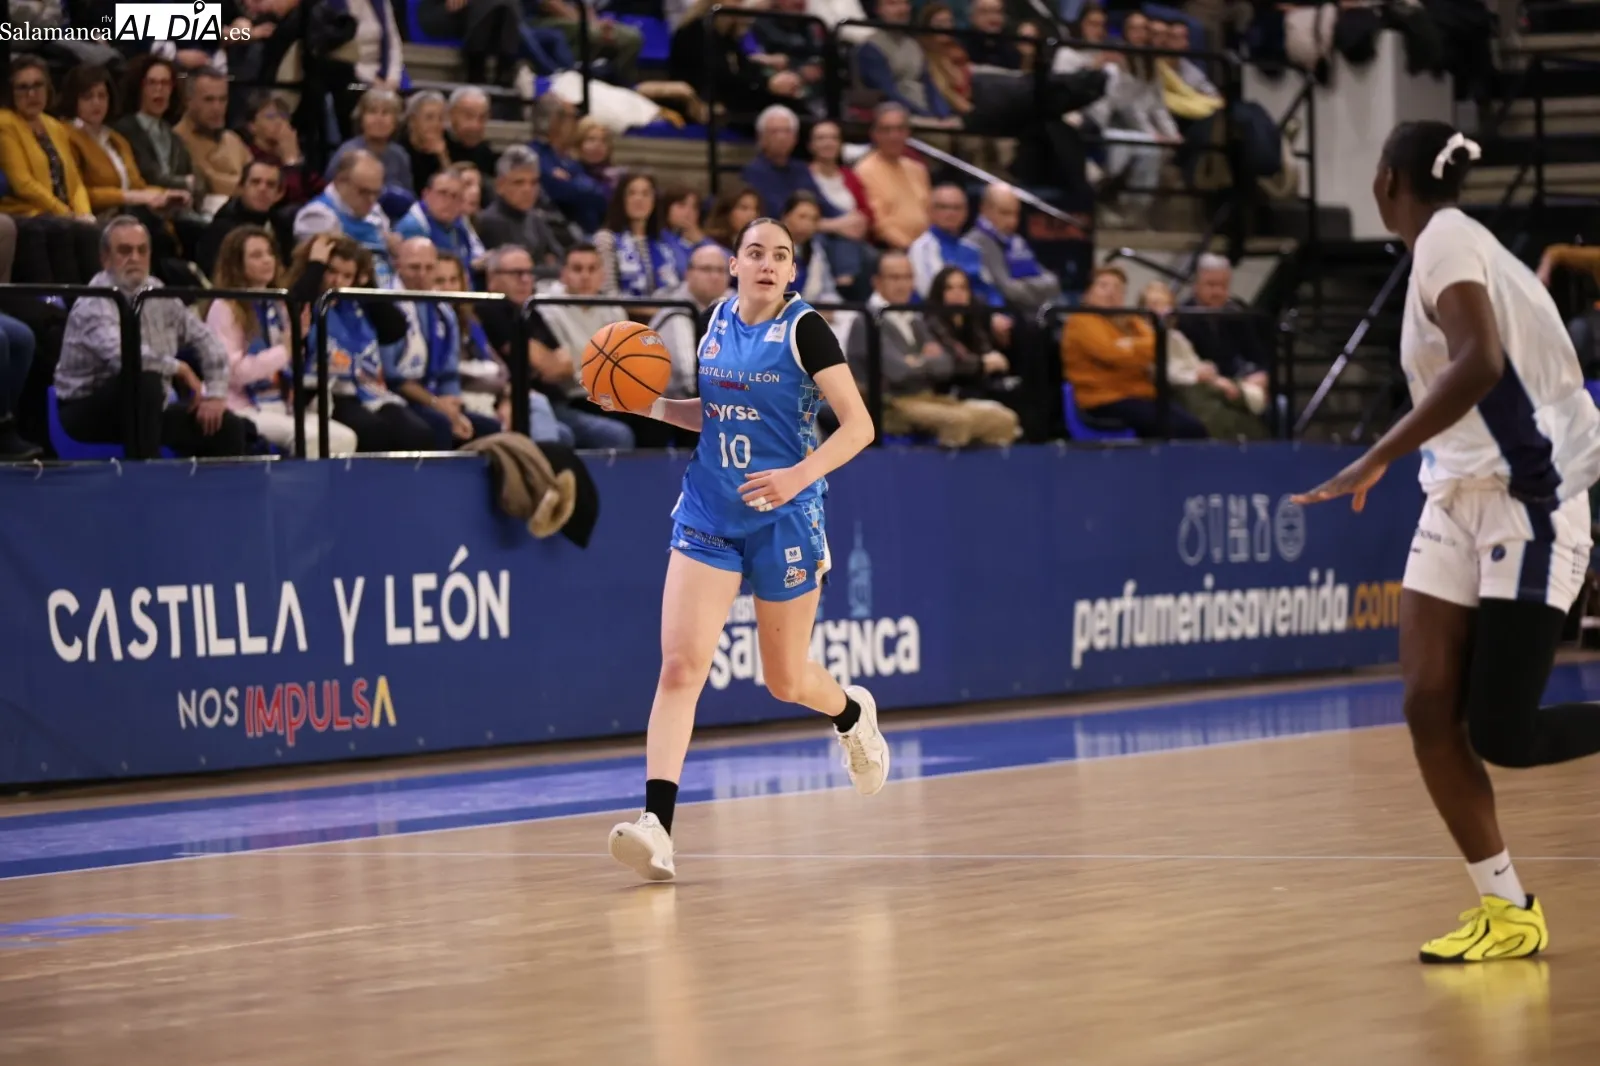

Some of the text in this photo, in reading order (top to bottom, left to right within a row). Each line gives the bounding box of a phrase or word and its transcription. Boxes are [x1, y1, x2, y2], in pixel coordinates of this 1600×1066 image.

[698, 365, 780, 383] CASTILLA Y LEÓN
[718, 432, 751, 469] 10
[47, 545, 510, 665] CASTILLA Y LEÓN
[177, 675, 397, 747] NOS IMPULSA
